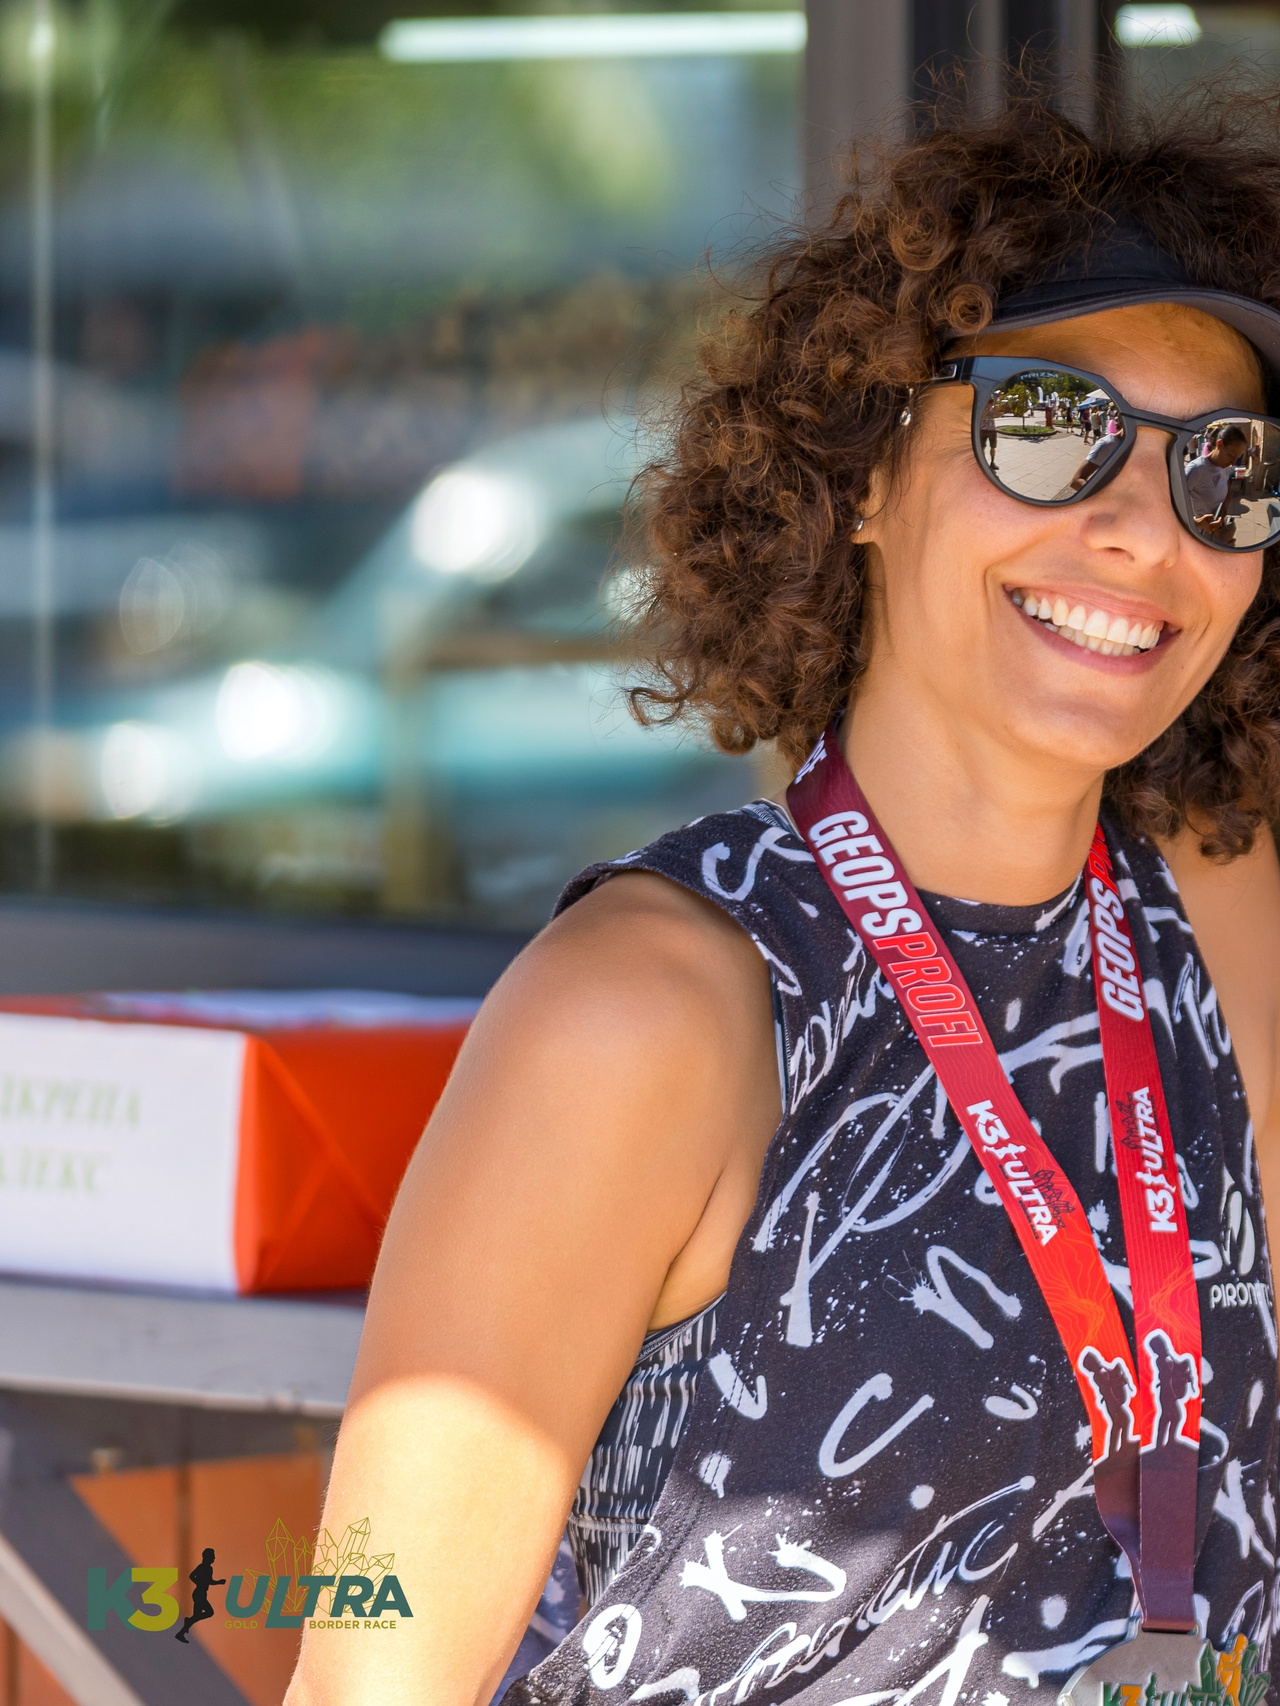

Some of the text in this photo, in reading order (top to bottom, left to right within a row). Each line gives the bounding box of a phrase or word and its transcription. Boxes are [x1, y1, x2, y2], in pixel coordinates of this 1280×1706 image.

[966, 1099, 1010, 1145] K3
[1004, 1160, 1058, 1247] ULTRA
[1133, 1086, 1178, 1232] K3 ULTRA
